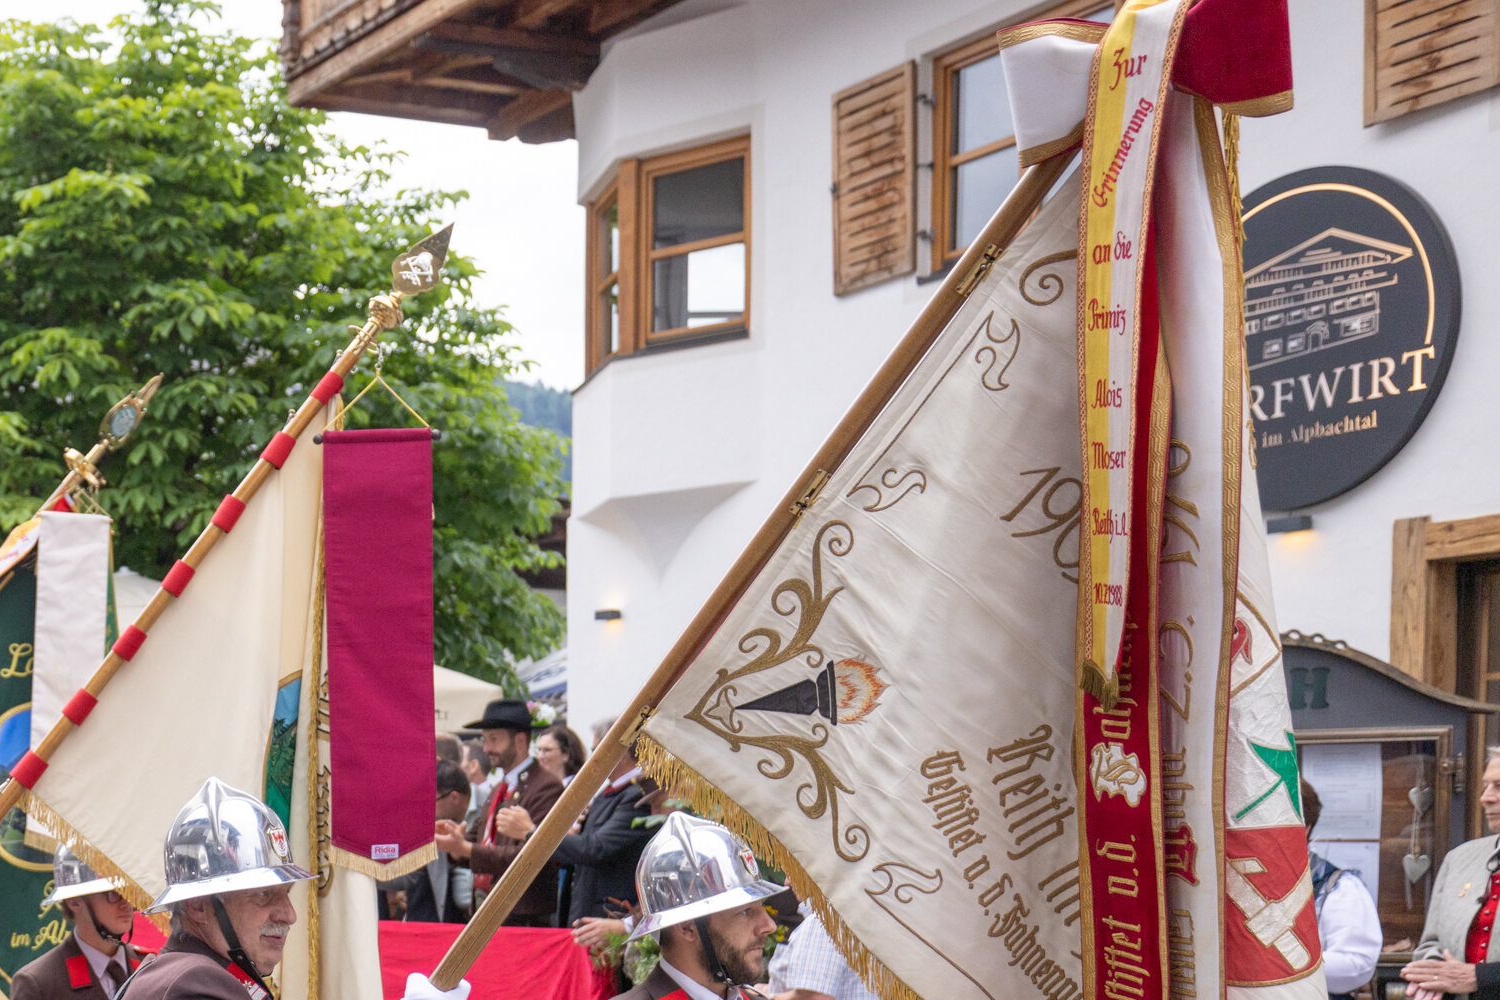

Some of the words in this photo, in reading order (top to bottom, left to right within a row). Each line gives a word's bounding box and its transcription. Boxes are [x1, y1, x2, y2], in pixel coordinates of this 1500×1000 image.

[1109, 47, 1148, 91] Zur
[1092, 97, 1155, 208] Erinnerung
[1092, 244, 1111, 265] an
[1113, 230, 1132, 261] die
[1088, 298, 1126, 336] Primiz
[1092, 378, 1122, 409] Alois
[1289, 409, 1378, 444] Alpbachtal
[1091, 441, 1127, 470] Moser
[987, 724, 1075, 861] Reith
[10, 932, 31, 948] im
